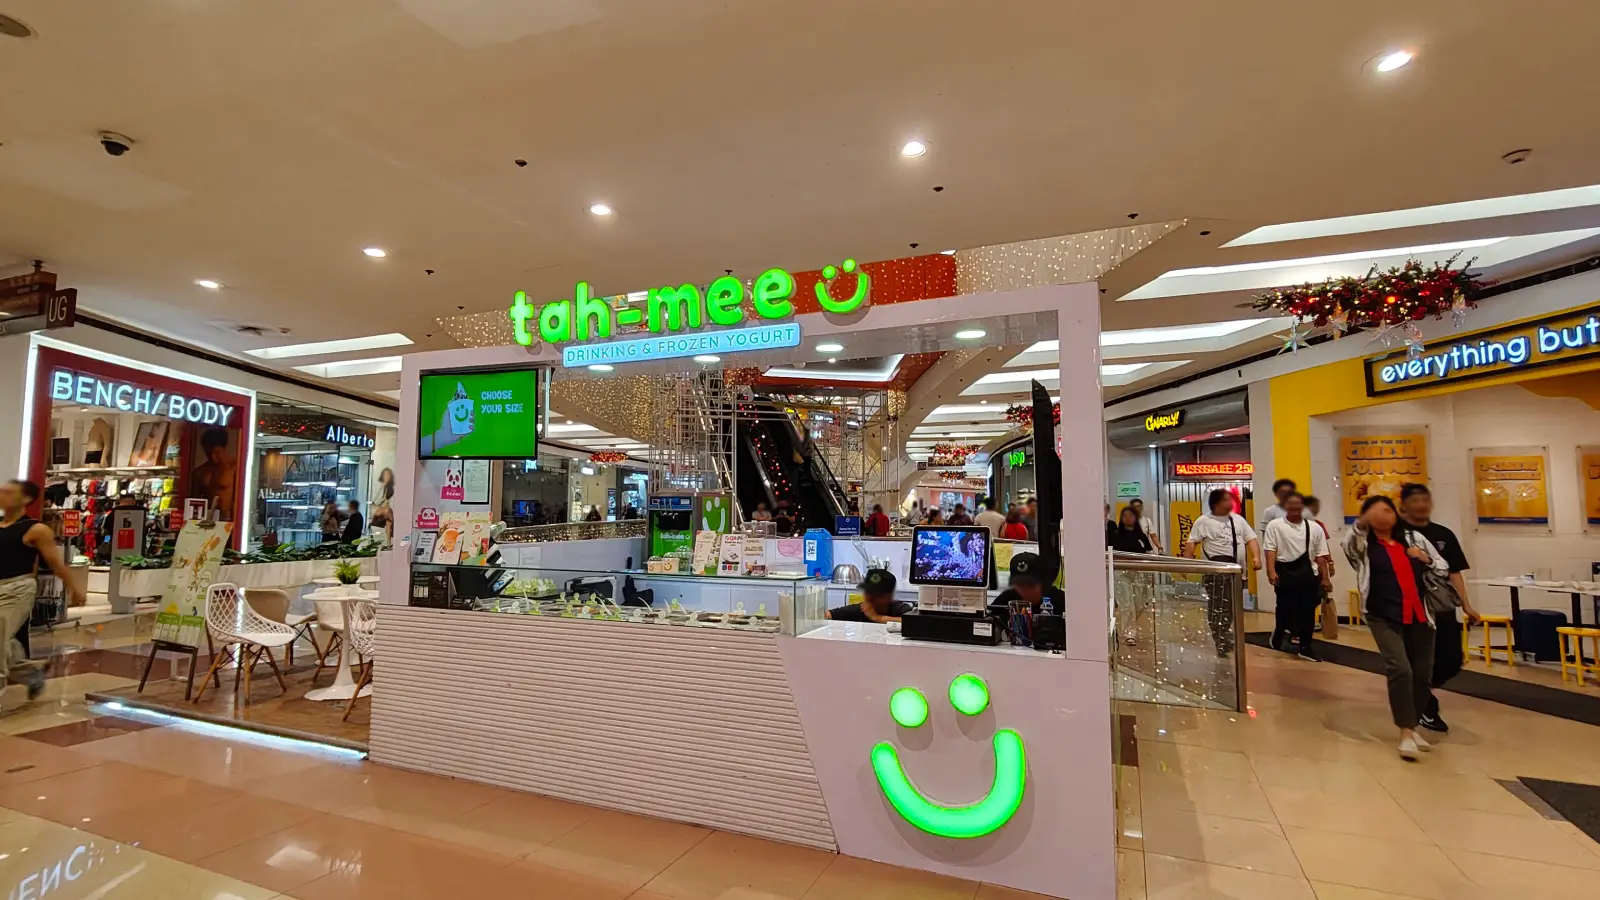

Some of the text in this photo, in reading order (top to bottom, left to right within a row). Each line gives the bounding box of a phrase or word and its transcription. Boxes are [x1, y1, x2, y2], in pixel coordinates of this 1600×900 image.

[49, 295, 68, 322] UG
[510, 268, 794, 346] tah-mee
[566, 328, 795, 363] DRINKING & FROZEN YOGURT
[1381, 317, 1600, 383] everything but
[481, 389, 513, 400] CHOOSE
[481, 403, 524, 414] YOUR SIZE
[1145, 411, 1180, 431] GNARLY!
[326, 425, 374, 448] Alberto
